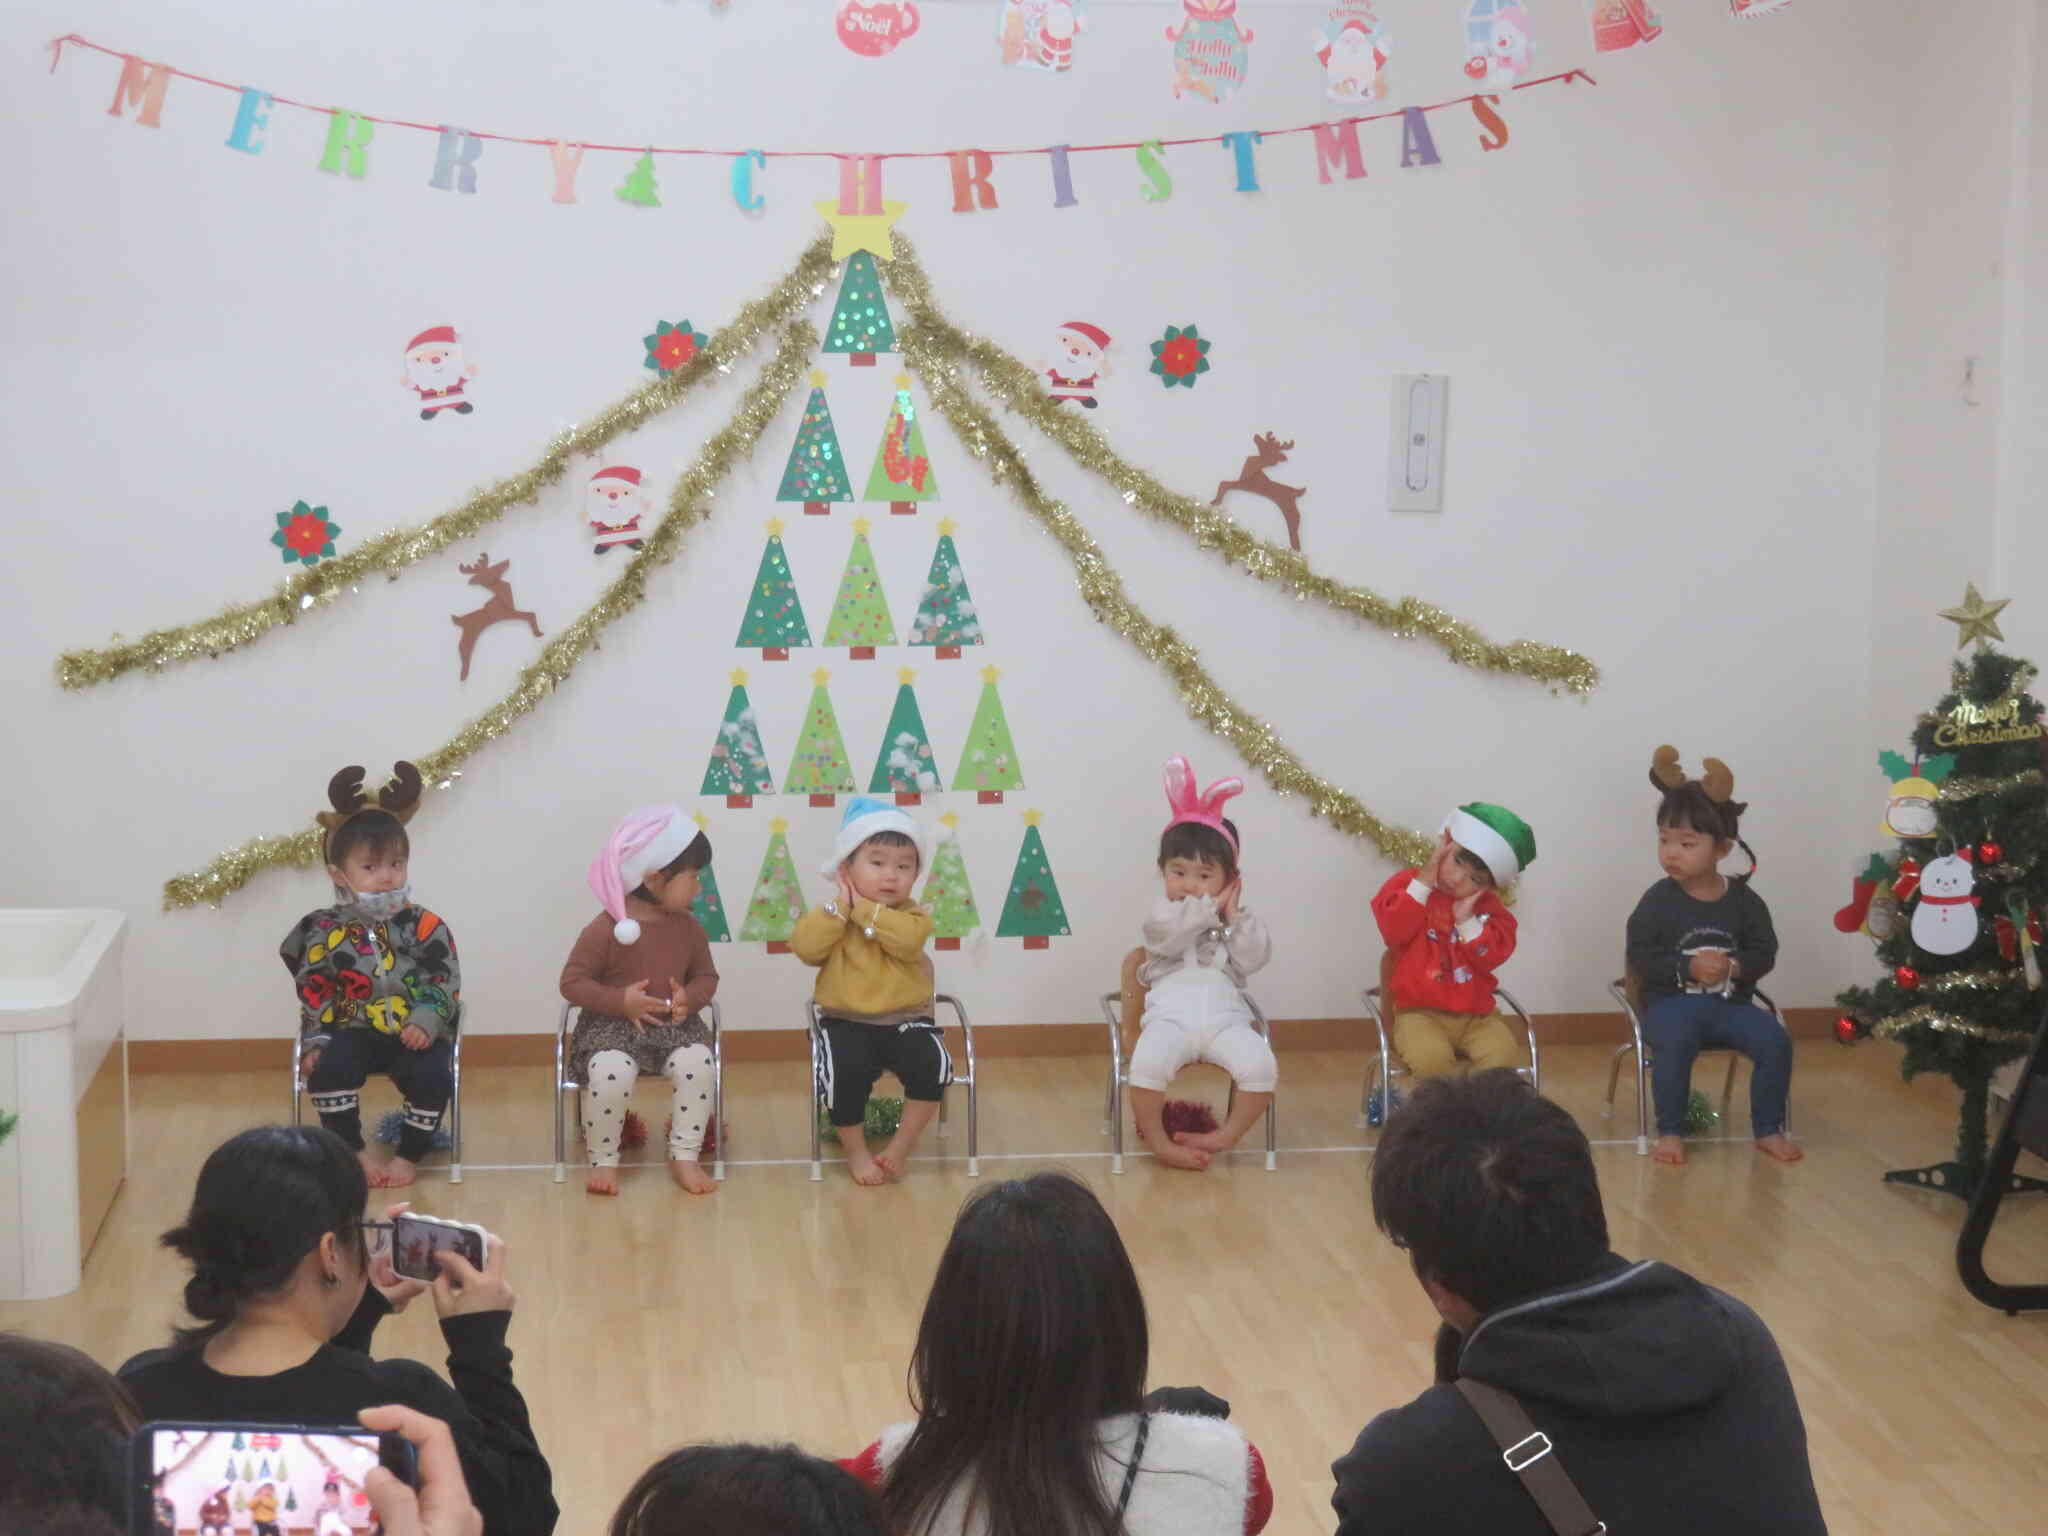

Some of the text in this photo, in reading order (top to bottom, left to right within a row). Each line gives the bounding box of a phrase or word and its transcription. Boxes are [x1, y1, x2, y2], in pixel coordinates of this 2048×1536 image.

[107, 55, 1509, 215] MERRY CHRISTMAS
[1948, 699, 2020, 728] Merry
[1934, 721, 2042, 748] Christmas
